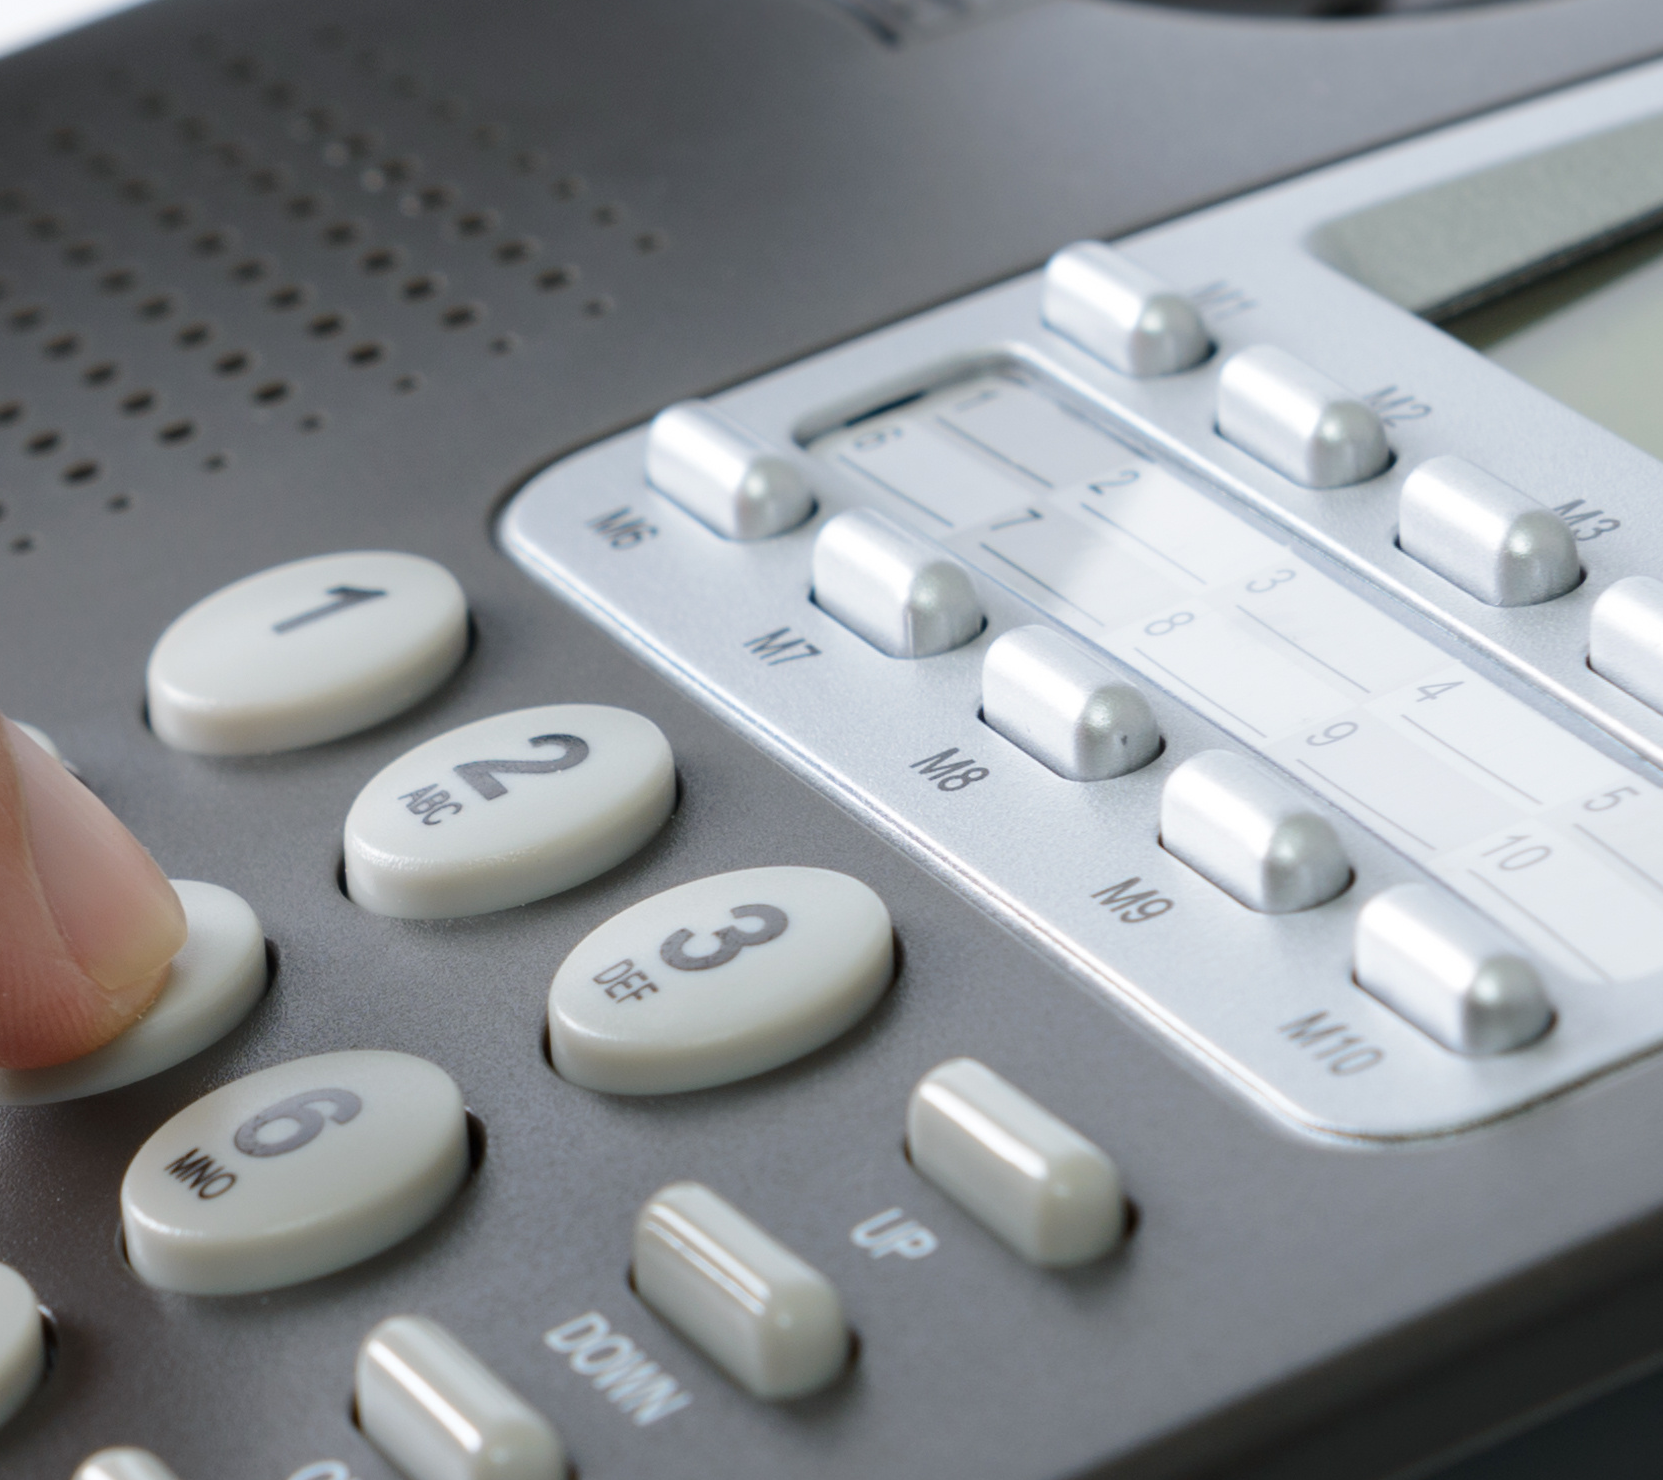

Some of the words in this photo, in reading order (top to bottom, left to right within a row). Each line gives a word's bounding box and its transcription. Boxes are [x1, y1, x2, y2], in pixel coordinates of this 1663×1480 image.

[1363, 386, 1432, 428] M2
[1090, 470, 1140, 496] 2
[587, 505, 659, 552] M6
[990, 506, 1044, 532] 7
[1553, 498, 1622, 543] M3
[1245, 568, 1298, 595] 3
[272, 585, 388, 635] 1
[1143, 610, 1196, 638] 8
[744, 626, 822, 667] M7
[1415, 678, 1466, 704] 4
[1305, 720, 1360, 748] 9
[453, 733, 591, 801] 2
[909, 747, 991, 793] M8
[397, 783, 464, 826] ABC
[1582, 785, 1641, 813] 5
[1481, 832, 1553, 872] 10
[1090, 876, 1176, 924] M9
[659, 903, 790, 972] 3
[592, 958, 661, 1004] DEF
[1278, 1009, 1386, 1077] M10
[233, 1087, 364, 1158] 6
[164, 1147, 239, 1201] MNO
[849, 1207, 940, 1261] UP
[543, 1311, 694, 1427] DOWN
